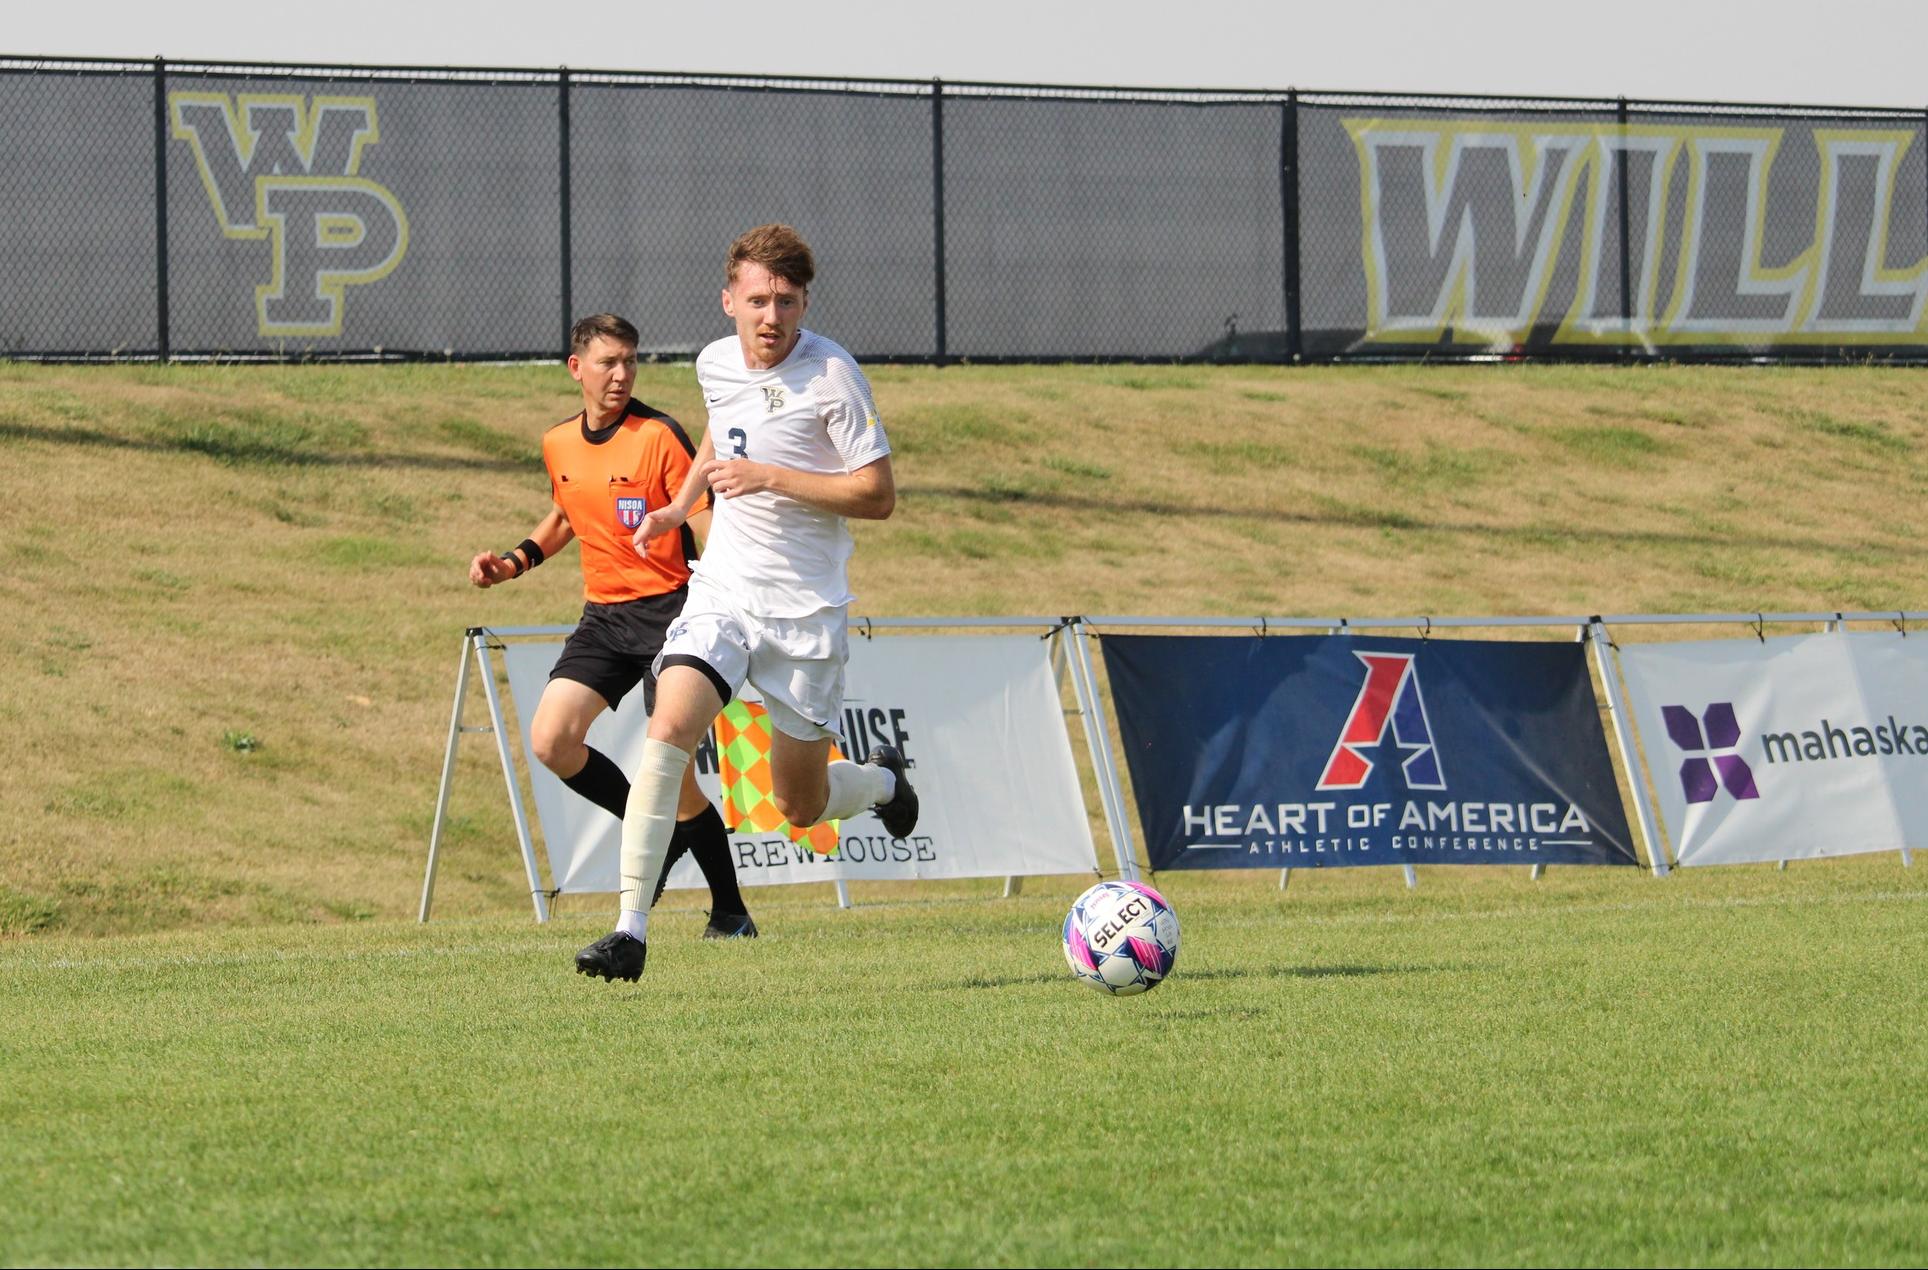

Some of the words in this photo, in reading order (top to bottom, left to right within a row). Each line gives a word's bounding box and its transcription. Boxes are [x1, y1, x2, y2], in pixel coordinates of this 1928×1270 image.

[728, 427, 749, 460] 3
[618, 499, 643, 510] NISOA
[1761, 715, 1928, 763] mahaska
[1183, 802, 1336, 836] HEART
[1347, 803, 1392, 829] OF
[1399, 800, 1590, 833] AMERICA
[1249, 837, 1370, 854] ATHLETIC
[1392, 836, 1538, 850] CONFERENCE
[1094, 898, 1147, 949] SELECT
